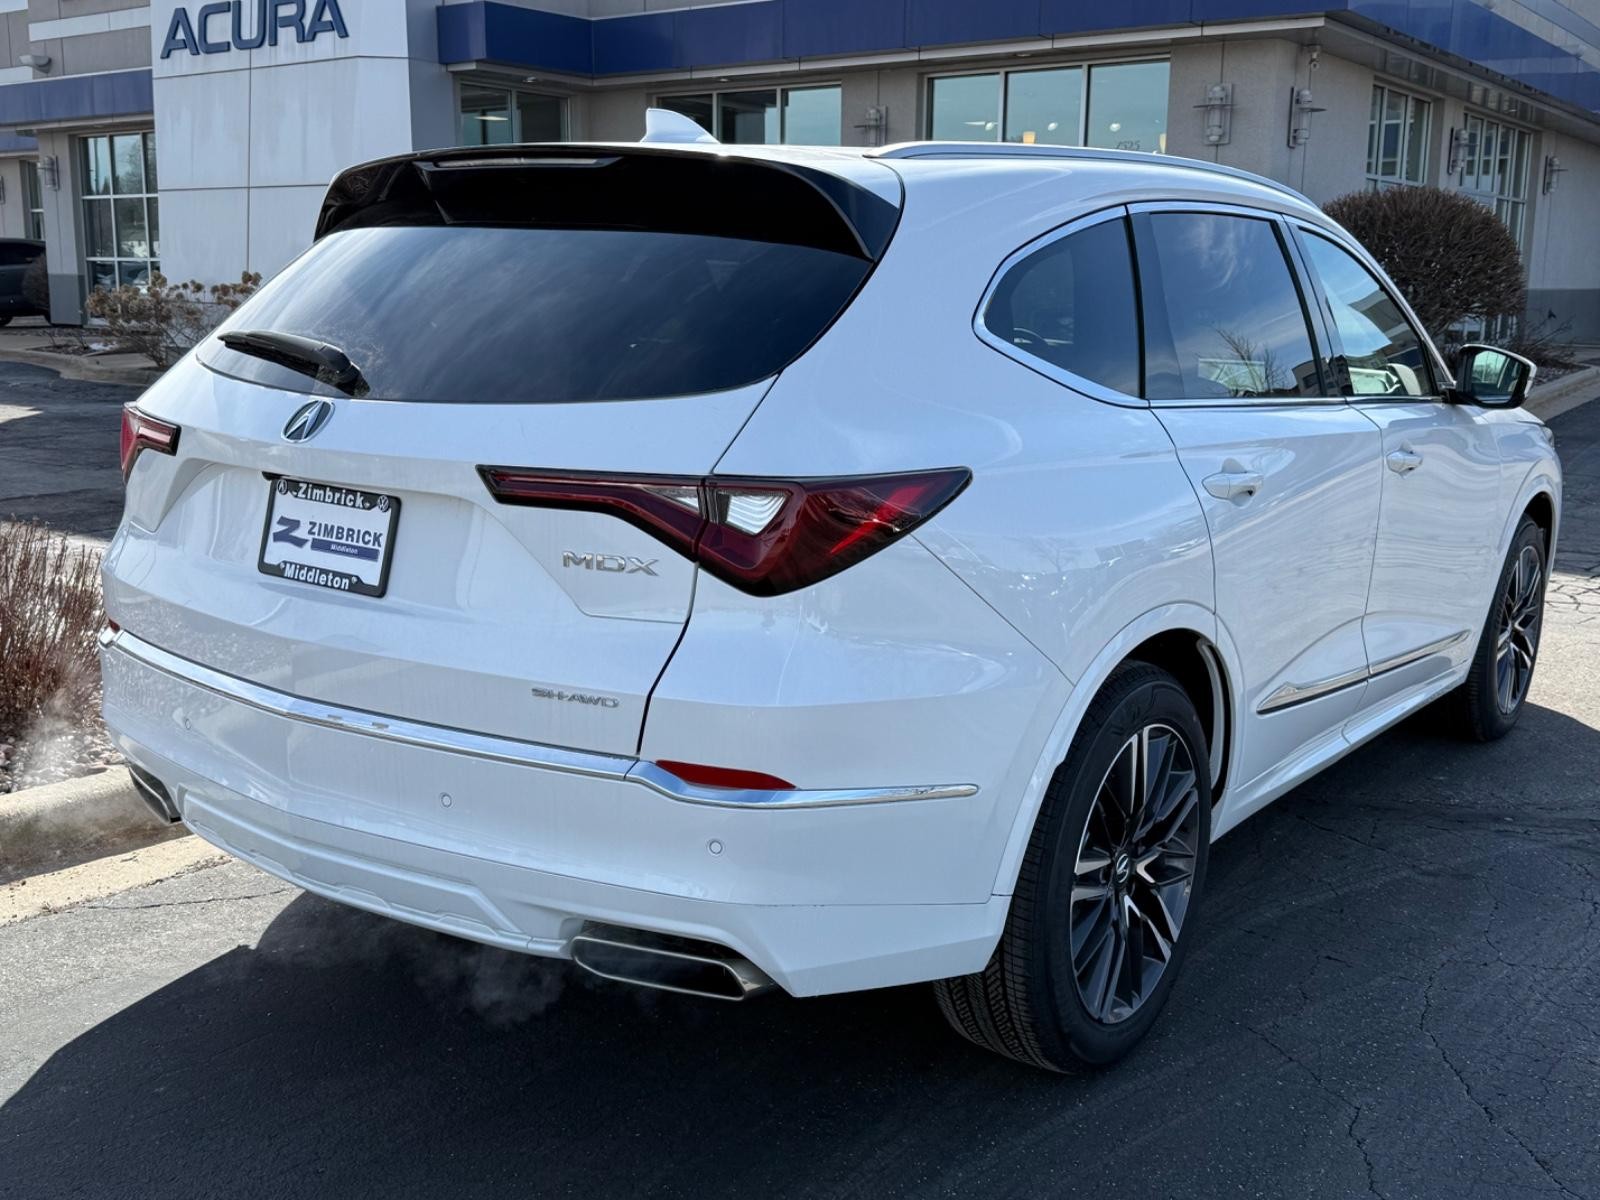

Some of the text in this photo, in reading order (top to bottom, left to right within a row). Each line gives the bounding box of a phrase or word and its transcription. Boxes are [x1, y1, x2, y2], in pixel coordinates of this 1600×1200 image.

[160, 0, 349, 59] ACURA
[297, 482, 365, 508] Zimbrick
[307, 521, 383, 548] ZIMBRICK
[330, 543, 359, 555] Middleton
[283, 563, 350, 590] Middleton
[562, 551, 659, 577] MDX
